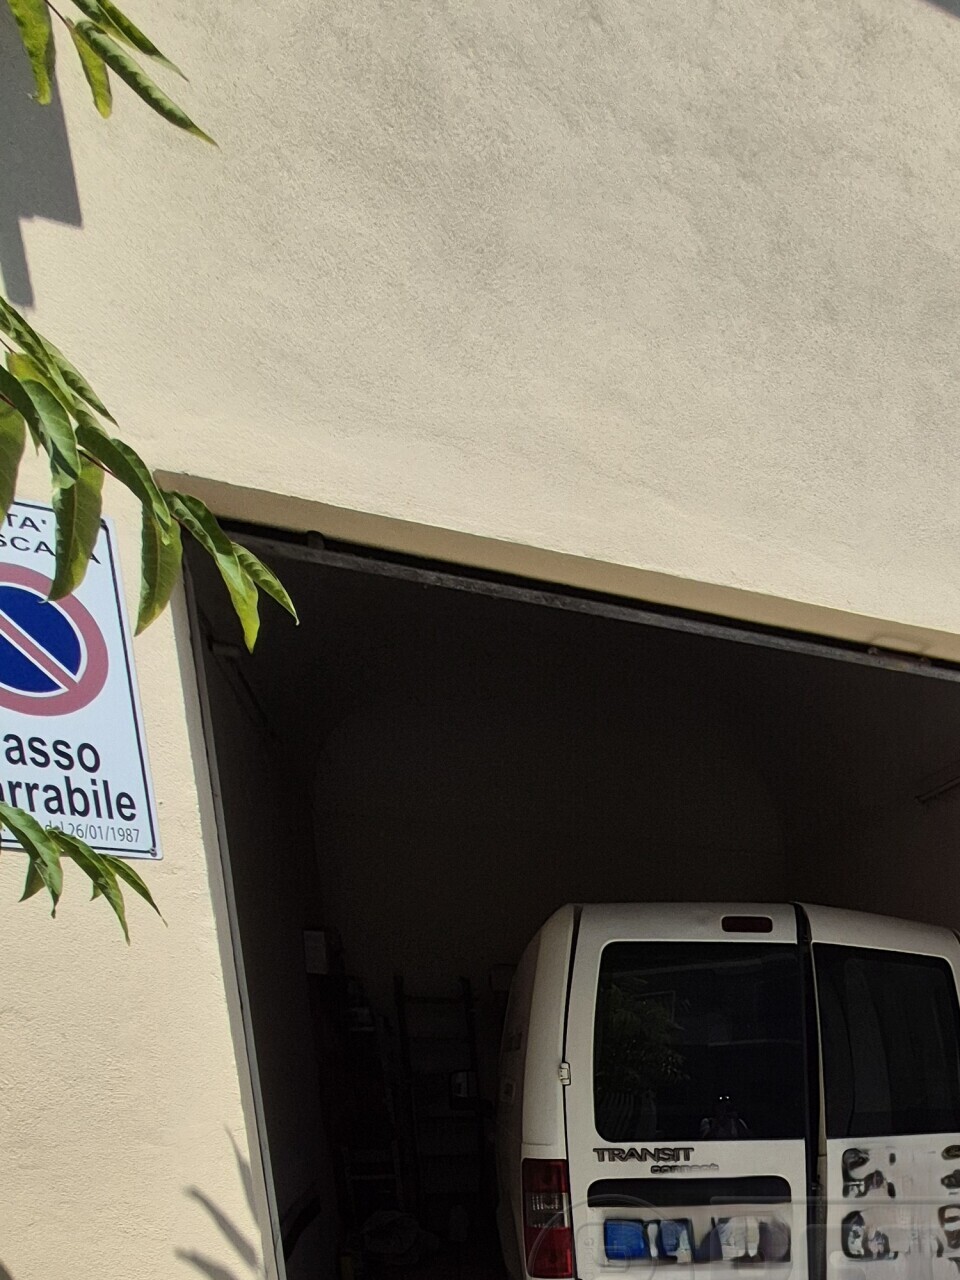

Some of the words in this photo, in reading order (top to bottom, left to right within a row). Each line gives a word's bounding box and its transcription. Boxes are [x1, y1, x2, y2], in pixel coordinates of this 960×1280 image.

[3, 733, 101, 774] asso
[0, 775, 137, 822] rrabile
[68, 823, 140, 843] 26/01/1987
[592, 1147, 695, 1162] TRANSIT
